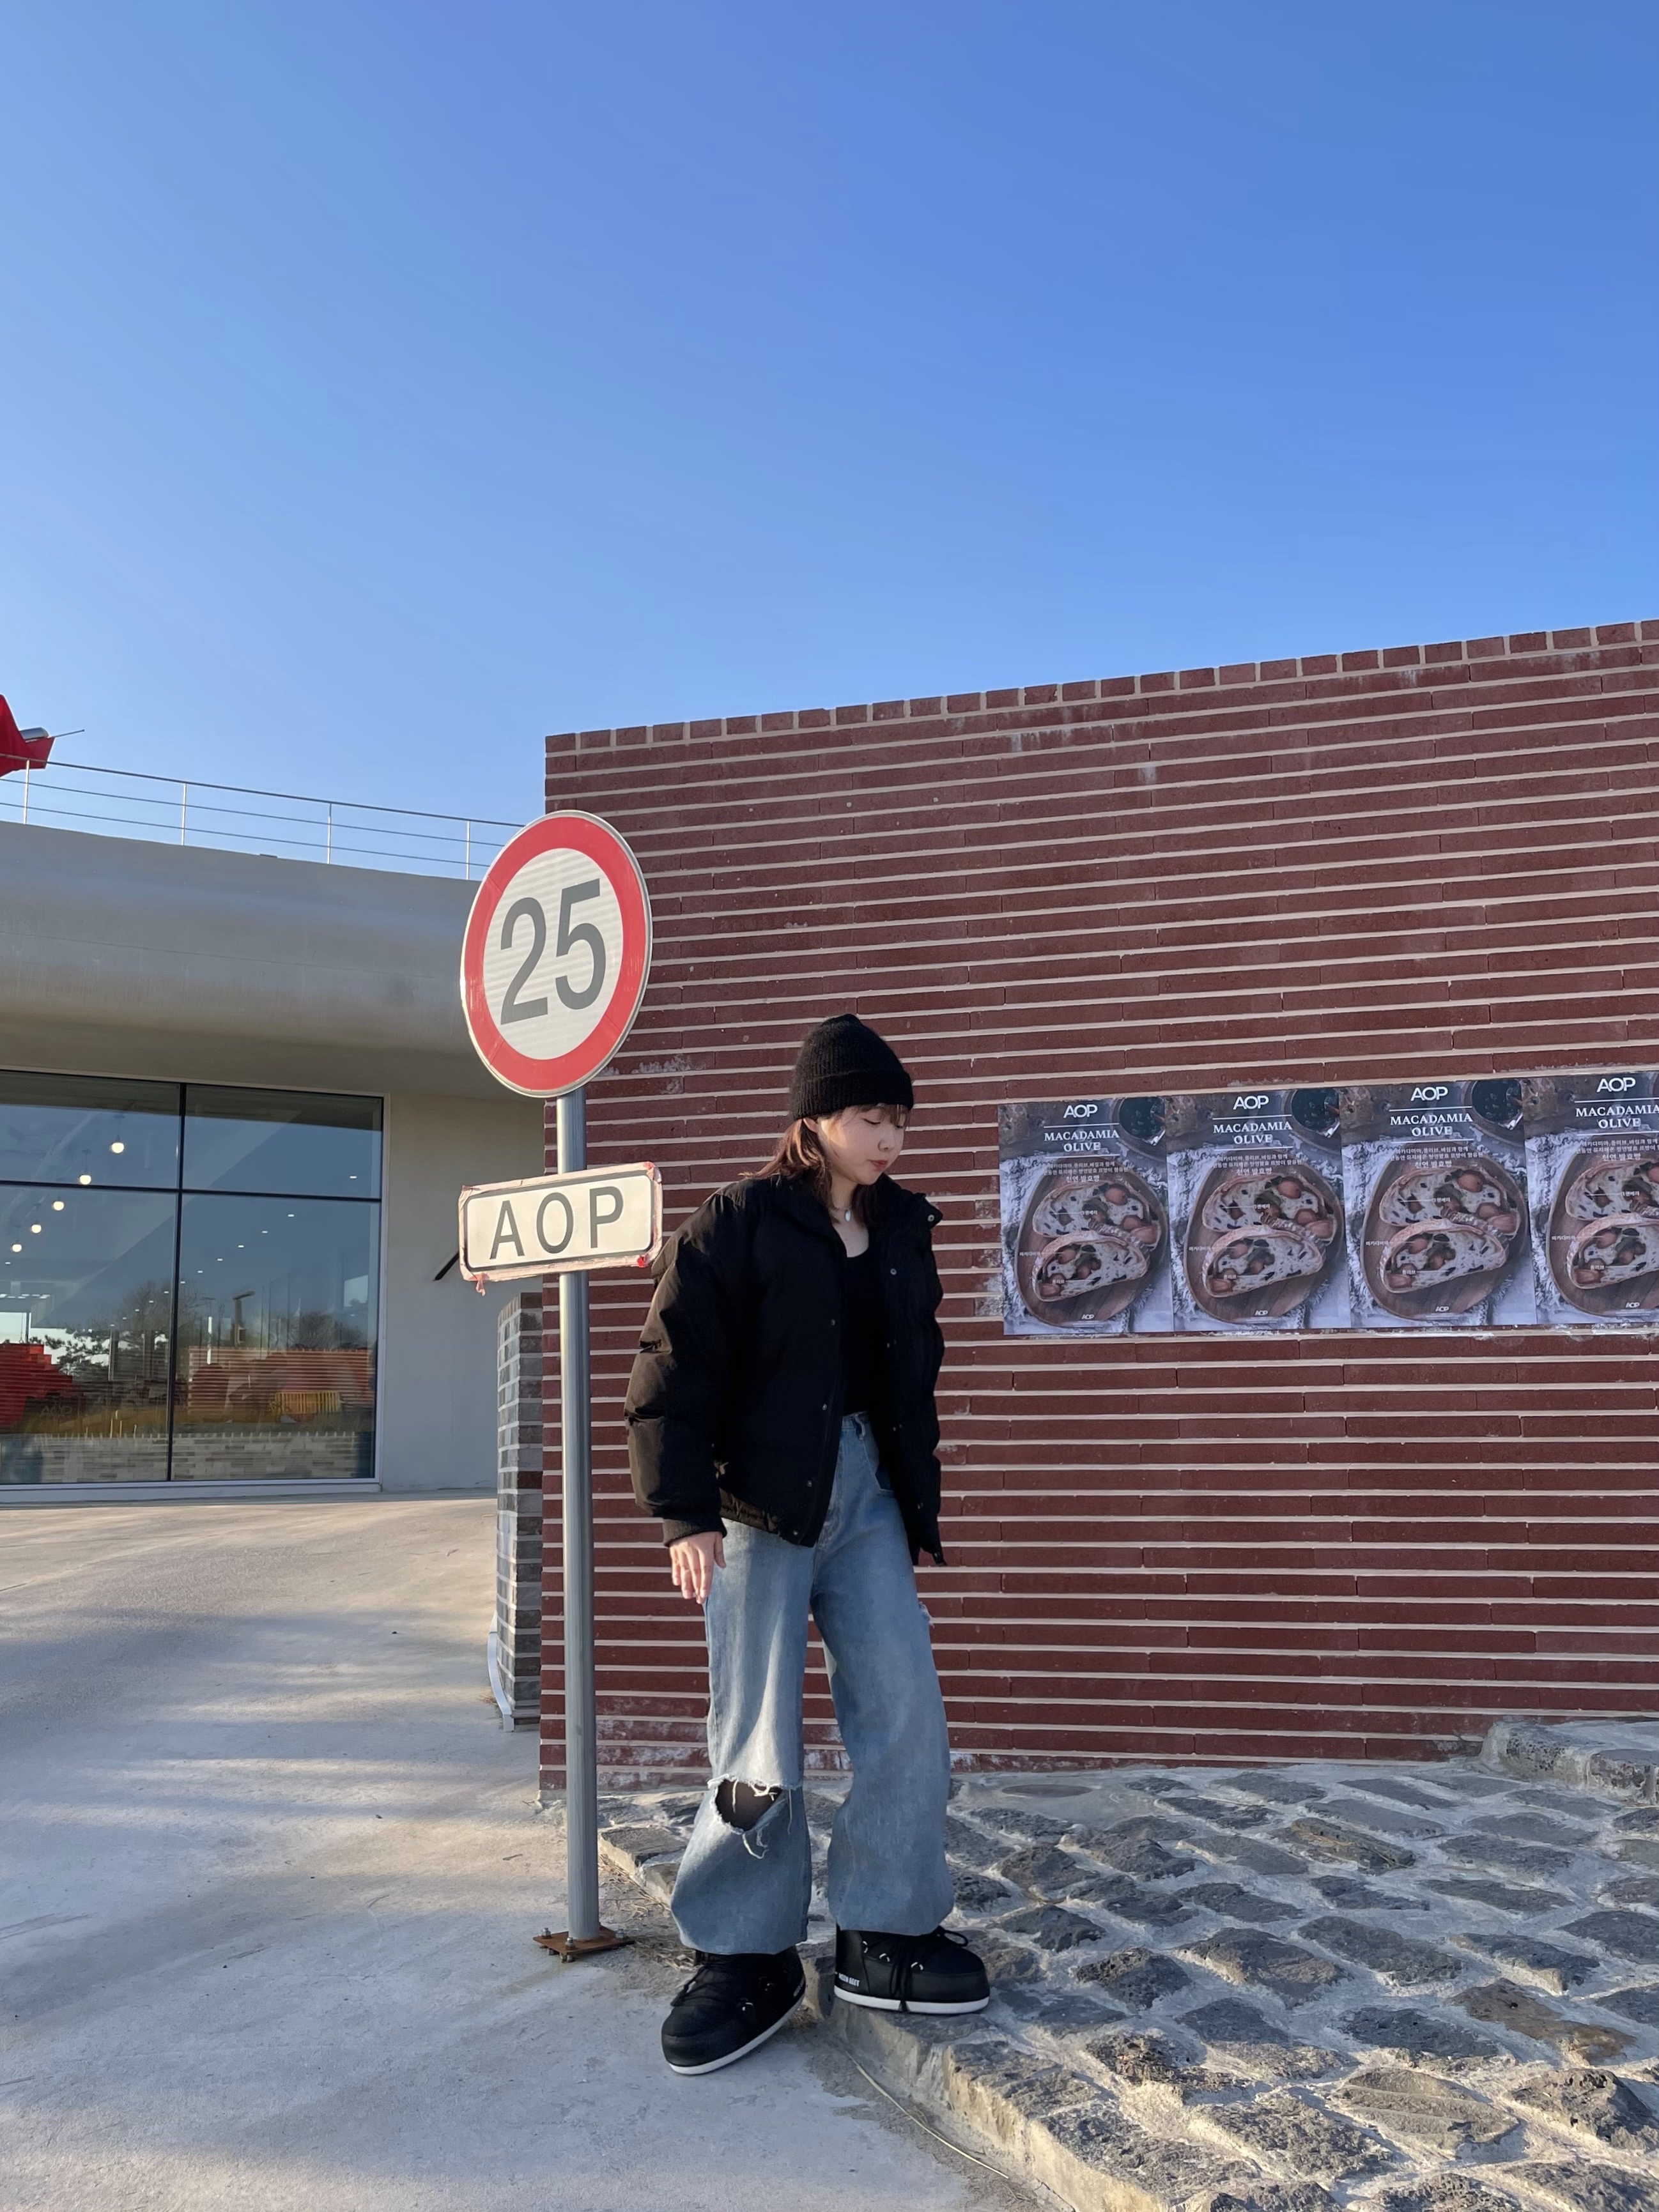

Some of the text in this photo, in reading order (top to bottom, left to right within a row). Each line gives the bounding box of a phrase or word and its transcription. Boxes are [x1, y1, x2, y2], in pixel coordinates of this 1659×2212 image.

[500, 879, 606, 1025] 25
[1596, 1077, 1636, 1093] AOP
[1410, 1086, 1449, 1102] AOP
[1233, 1095, 1269, 1110] AOP
[1063, 1104, 1098, 1118] AOP
[1575, 1105, 1659, 1117] MACADAMIA
[1390, 1113, 1473, 1125] MACADAMIA
[1598, 1118, 1641, 1128] OLIVE
[1213, 1121, 1292, 1133] MACADAMIA
[1412, 1126, 1453, 1137] OLIVE
[1044, 1130, 1120, 1141] MACADAMIA
[1233, 1134, 1273, 1144] OLIVE
[1063, 1142, 1100, 1152] OLIVE
[490, 1186, 624, 1259] AOP
